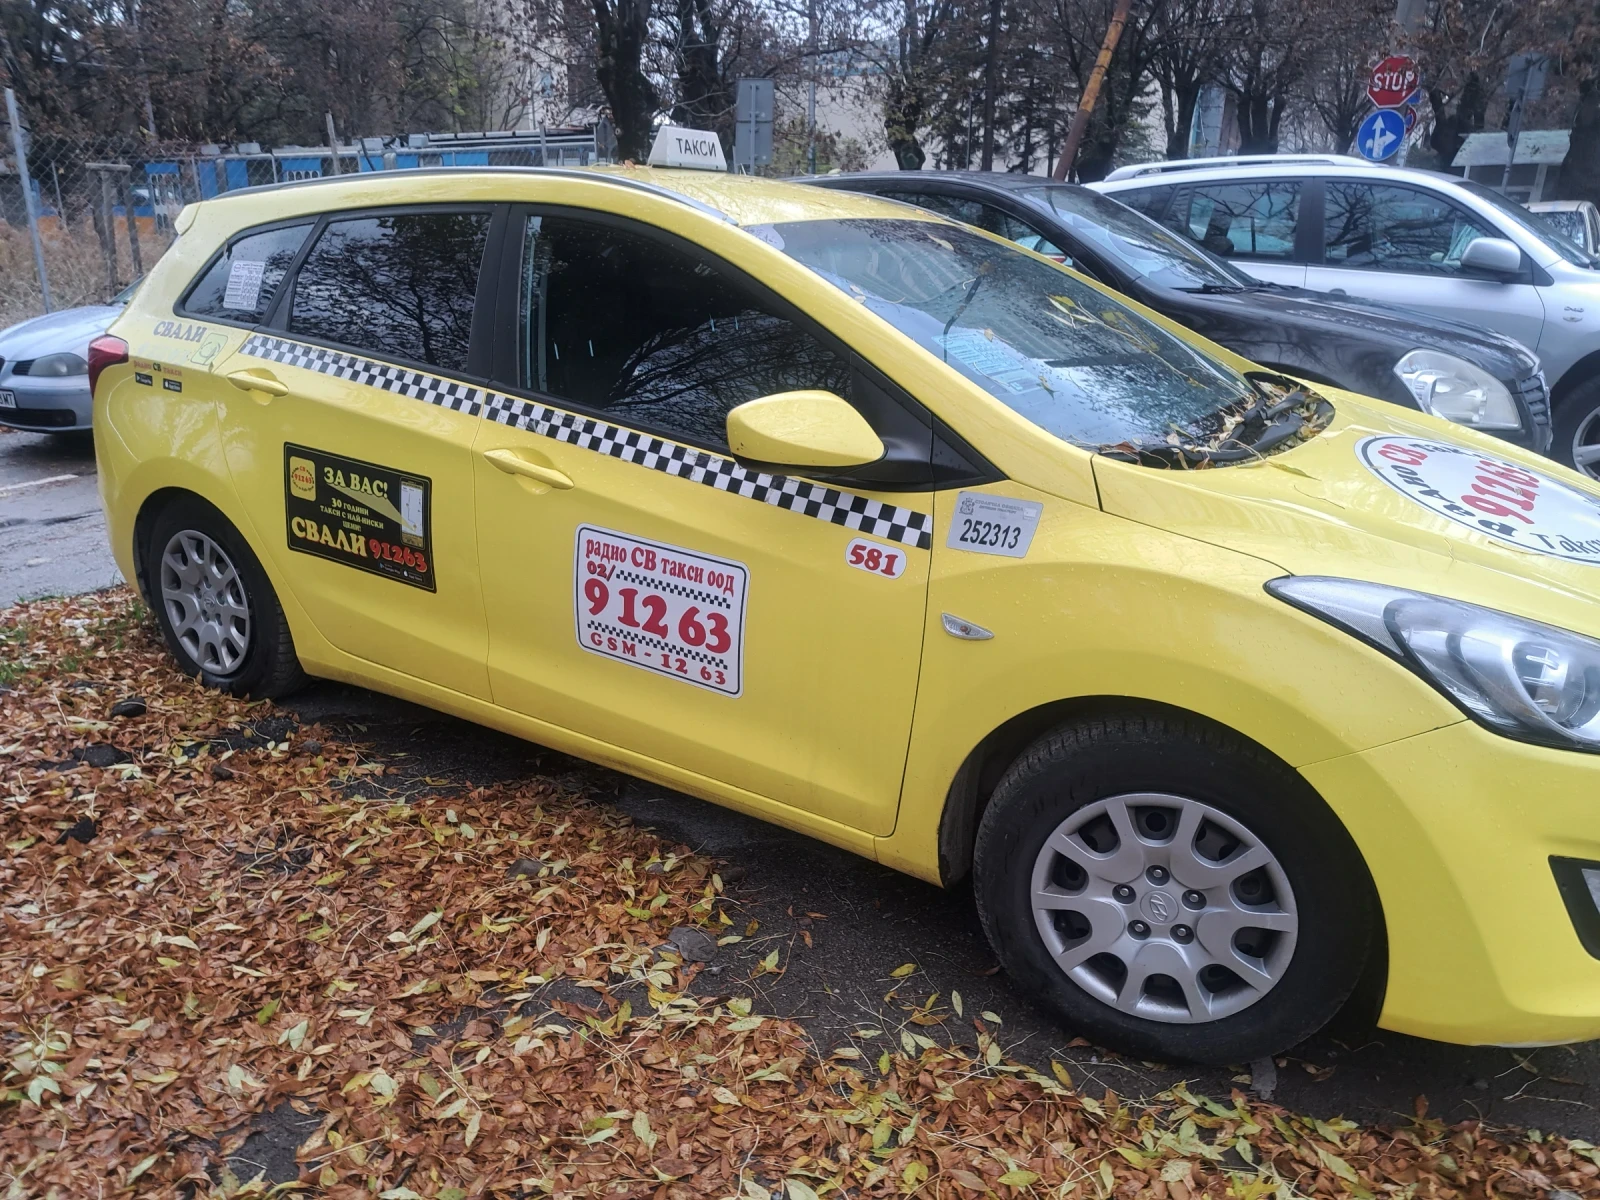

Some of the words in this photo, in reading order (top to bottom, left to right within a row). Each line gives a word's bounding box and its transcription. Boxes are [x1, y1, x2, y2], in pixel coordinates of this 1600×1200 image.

[1372, 71, 1415, 92] STOP
[675, 138, 717, 157] ТАКСИ
[153, 321, 207, 343] СВАЛИ
[1378, 444, 1428, 466] СВ
[324, 467, 346, 488] ЗА
[350, 472, 388, 499] ВАС!
[1460, 460, 1540, 524] 91263
[320, 505, 341, 517] ТАКСИ
[341, 511, 347, 519] С
[331, 497, 342, 508] 30
[291, 516, 368, 557] СВАЛИ
[369, 538, 427, 573] 91263
[959, 518, 1021, 549] 252313
[585, 538, 627, 564] радио
[631, 546, 657, 571] СВ
[660, 557, 704, 584] такси
[707, 570, 735, 598] оод
[586, 560, 616, 582] 02/
[849, 544, 898, 576] 581
[590, 632, 637, 657] GSM
